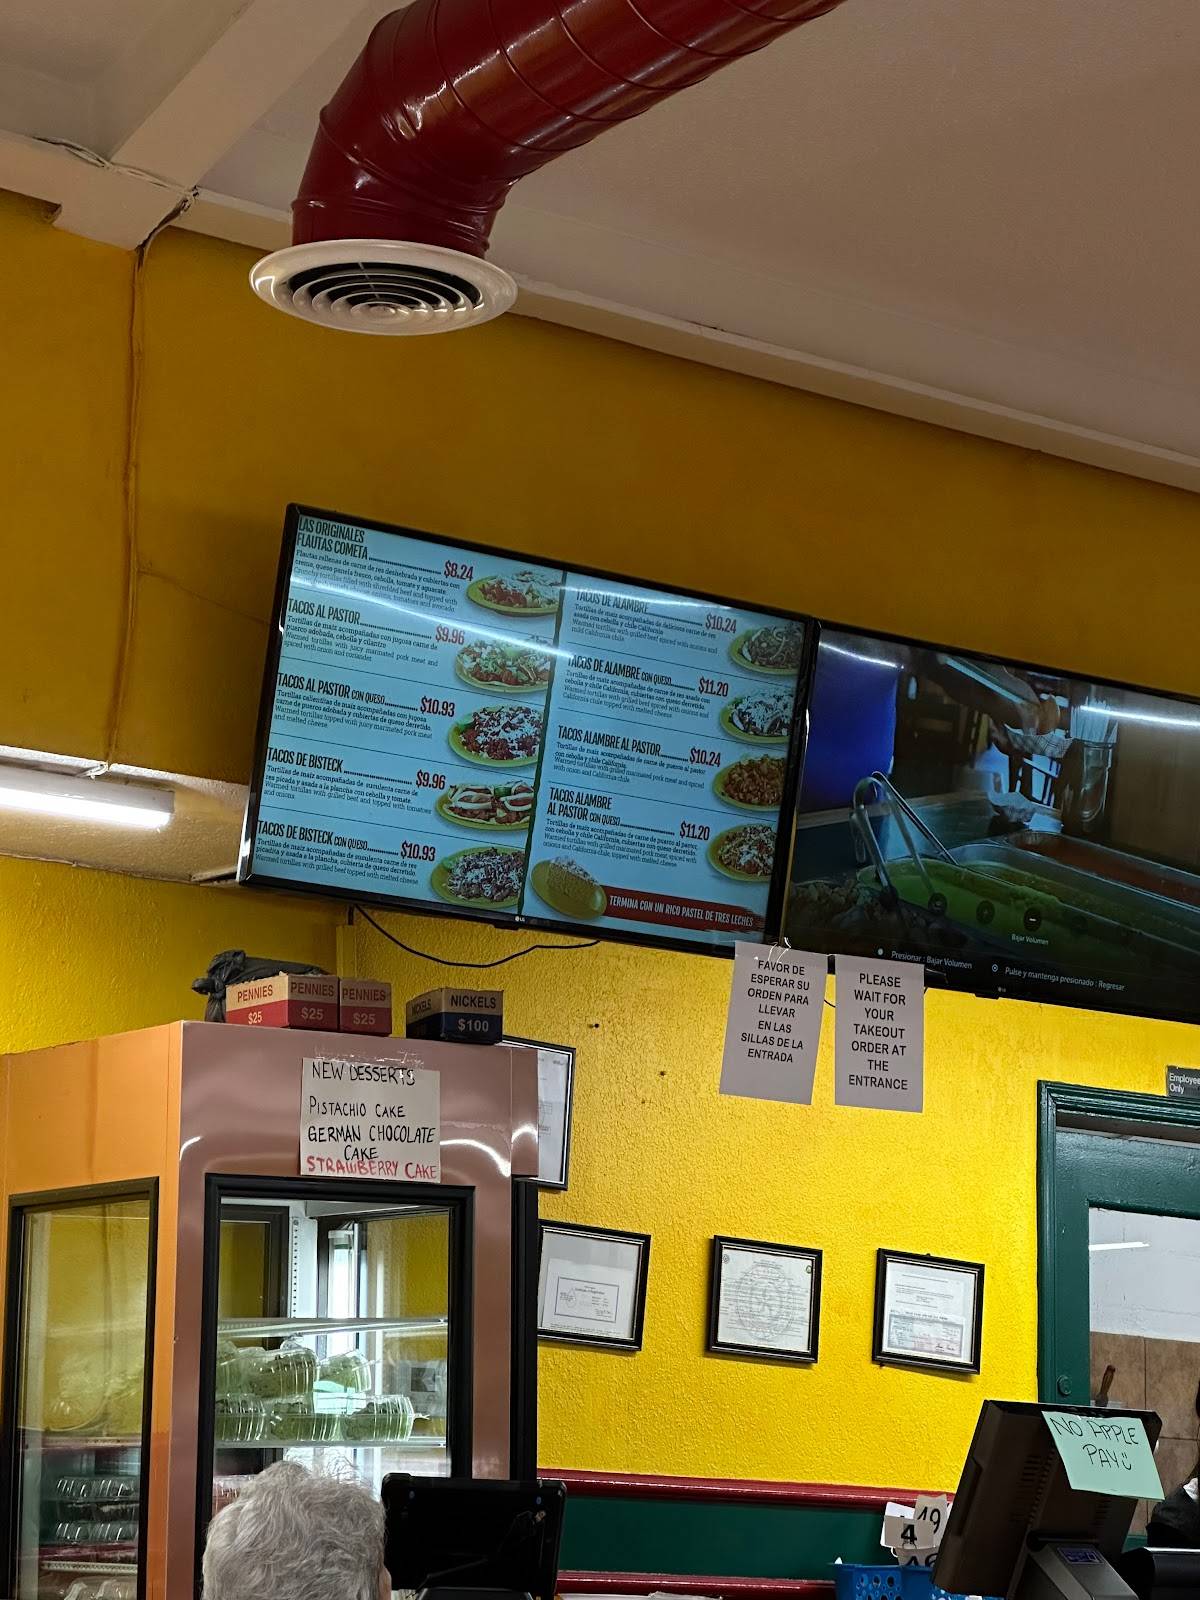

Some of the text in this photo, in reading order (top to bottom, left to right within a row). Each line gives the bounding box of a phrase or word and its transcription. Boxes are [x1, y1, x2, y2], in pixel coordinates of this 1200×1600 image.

[298, 517, 364, 543] LAS ORIGINALES
[296, 532, 474, 582] FLAUTAS COMETA $8.24
[287, 598, 465, 646] TACOS AL PASTOR $9.96
[705, 612, 737, 634] $10.24
[593, 658, 604, 672] DE
[604, 661, 641, 680] ALAMBRE
[641, 672, 653, 683] CON
[653, 674, 672, 688] QUESO
[698, 676, 728, 698] $11.20
[276, 672, 455, 719] TACOS AL PASTOR CON QUESO $10.93
[557, 725, 721, 768] TACOS ALAMBRE AL PASTOR $10.24
[266, 747, 446, 791] TACOS DE BISTECK $9.96
[549, 787, 612, 809] TACOS ALAMBRE
[547, 802, 710, 842] AL PASTOR CON QUESO $11.20
[257, 820, 436, 862] TACOS DE BISTECK CON QUESO $10.93
[609, 895, 753, 927] TERMINA CON UN RICO PASTEL DE TRES LECHES
[1012, 934, 1049, 945] Bajar Volumen
[758, 960, 804, 975] FAVOR DE
[891, 951, 921, 962] Presionar
[927, 956, 942, 966] Bajar
[944, 959, 972, 969] Volumen
[751, 974, 809, 990] ESPERAR SU
[859, 973, 900, 987] PLEASE
[1005, 967, 1021, 977] Pulse
[1028, 971, 1059, 983] mantenga
[1060, 975, 1094, 987] presionado
[1099, 980, 1125, 991] Regresar
[237, 985, 273, 1002] PENNIES
[290, 982, 334, 996] PENNIES
[342, 988, 386, 1001] PENNIES
[748, 988, 809, 1005] ORDEN PARA
[451, 995, 496, 1009] NICKELS
[854, 990, 905, 1005] WAIT FOR
[248, 1012, 262, 1024] $25
[301, 1007, 323, 1020] $25
[353, 1012, 375, 1025] $25
[759, 1004, 795, 1018] LLEVAR
[865, 1008, 894, 1020] YOUR
[458, 1019, 489, 1032] $100
[758, 1021, 791, 1033] EN LAS
[854, 1024, 905, 1039] TAKEOUT
[741, 1033, 803, 1049] SILLAS DE LA
[852, 1041, 906, 1055] ORDER AT
[748, 1049, 793, 1062] ENTRADA
[312, 1062, 415, 1085] NEW DESSERTS
[868, 1060, 888, 1071] THE
[849, 1075, 907, 1090] ENTRANCE
[1170, 1083, 1184, 1094] Only
[376, 1104, 405, 1118] CAKE
[308, 1125, 436, 1143] GERMAN CHOCOLATE
[344, 1145, 379, 1160] CAKE
[307, 1156, 436, 1179] STRAWBERRY CAKE
[1050, 1417, 1138, 1444] NO APPLE
[1082, 1444, 1119, 1468] PAY
